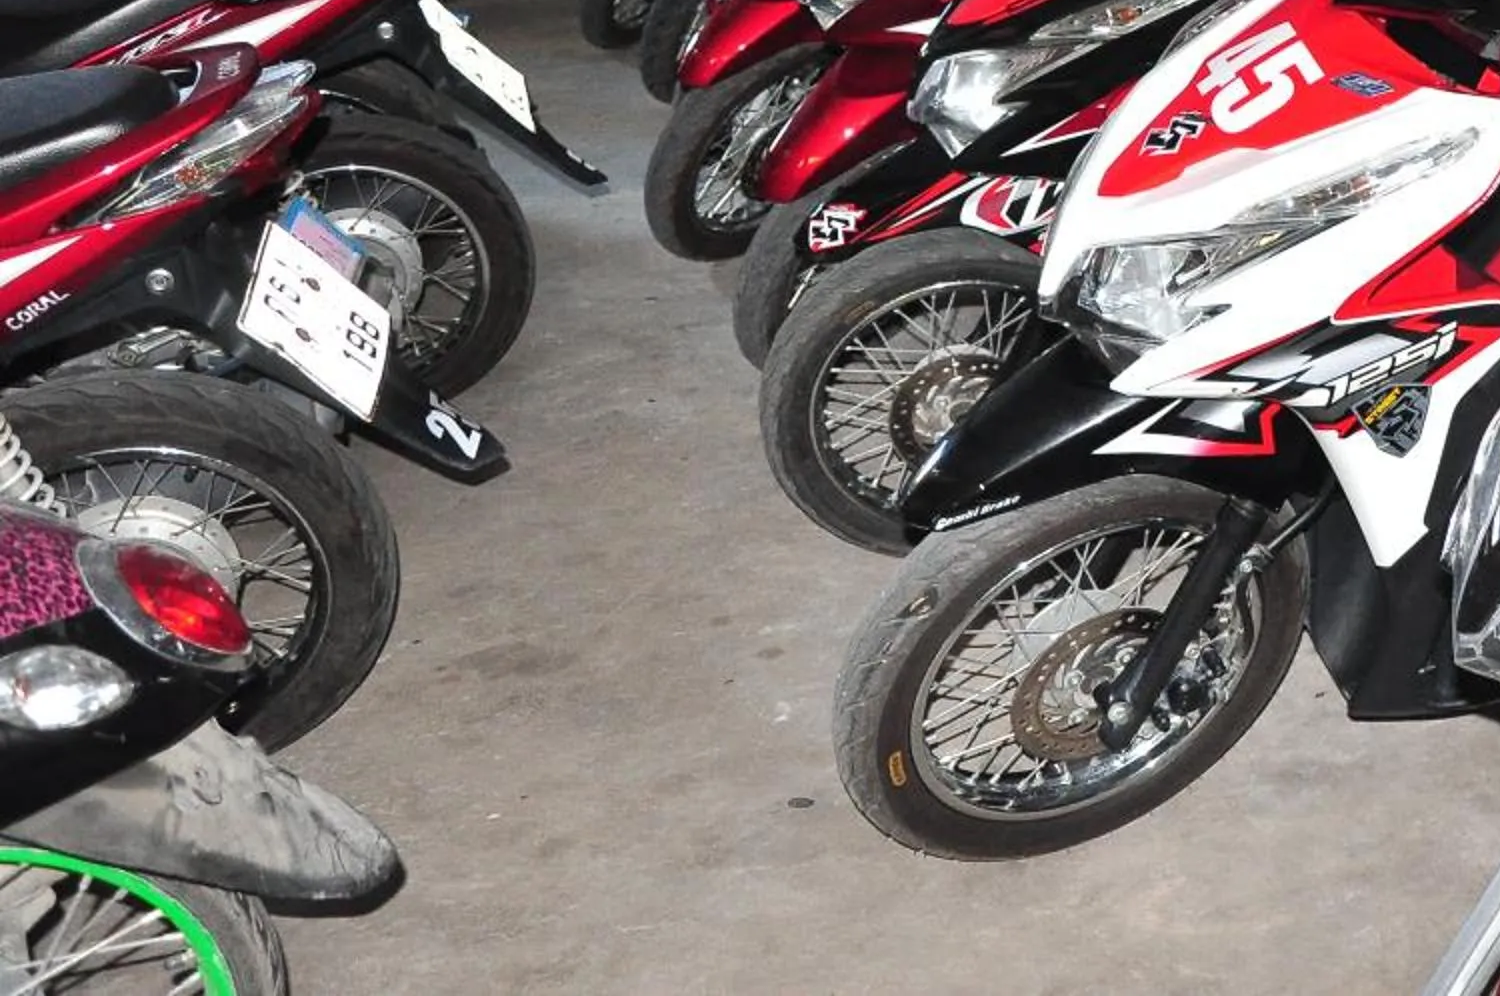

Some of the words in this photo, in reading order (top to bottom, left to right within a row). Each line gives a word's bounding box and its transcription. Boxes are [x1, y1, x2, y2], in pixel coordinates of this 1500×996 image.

[1195, 21, 1326, 134] 45
[5, 290, 72, 331] CORAL
[343, 310, 381, 373] 198
